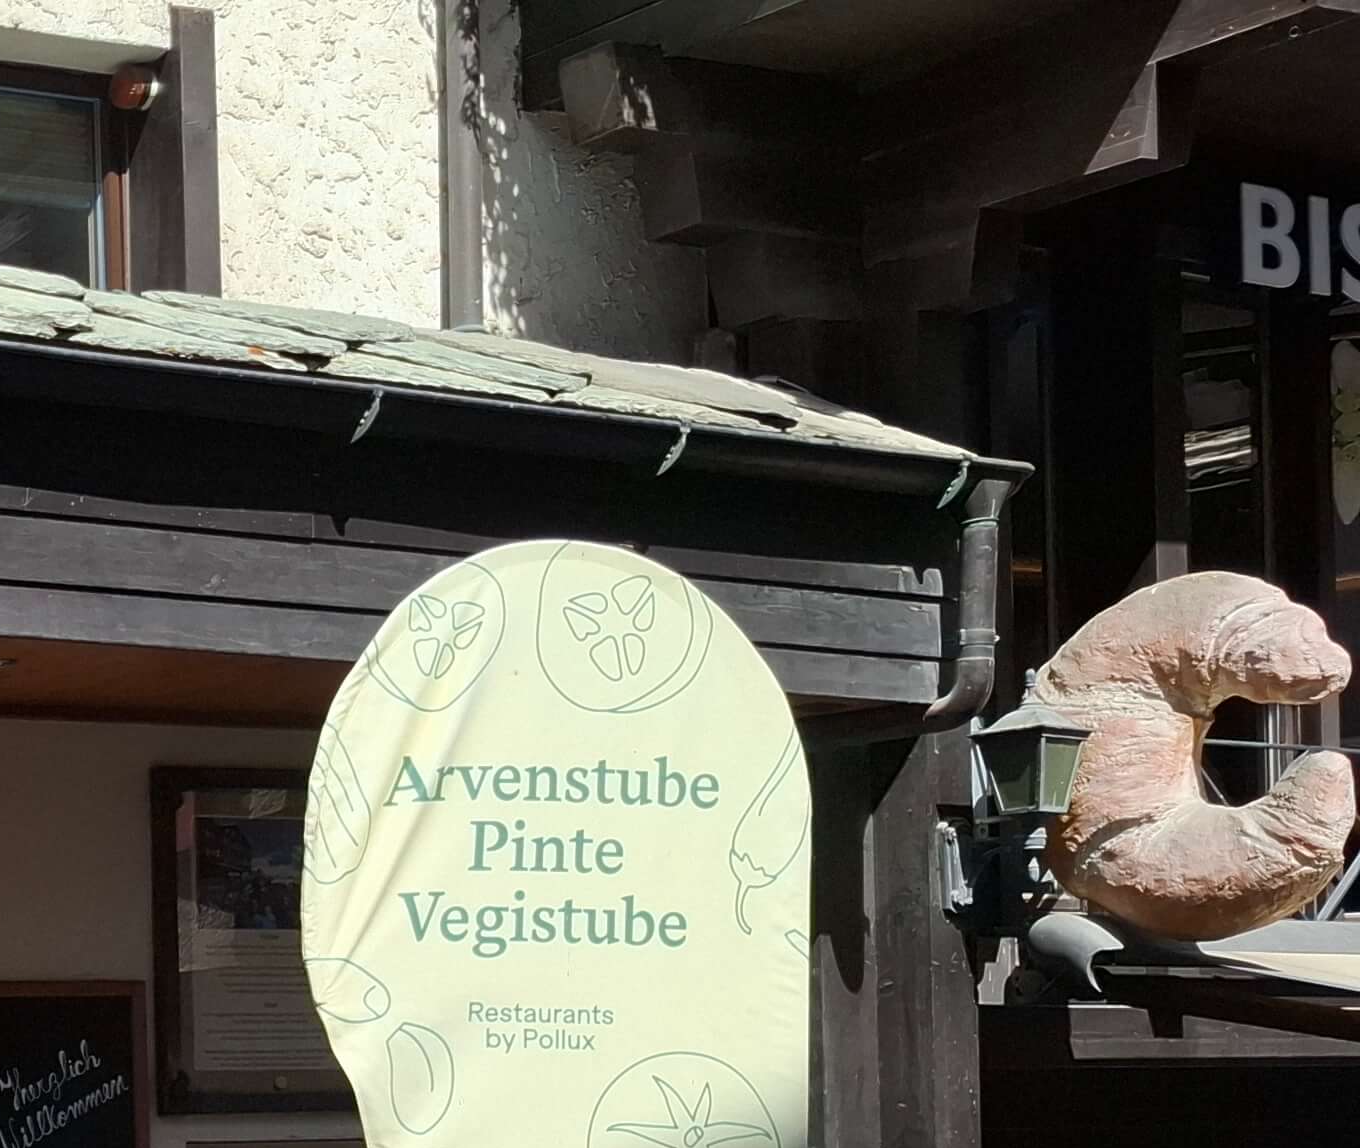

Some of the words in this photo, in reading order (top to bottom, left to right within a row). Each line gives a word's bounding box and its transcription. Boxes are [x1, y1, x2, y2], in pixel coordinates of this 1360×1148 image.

[383, 756, 720, 808] Arvenstube
[468, 820, 625, 875] Pinte
[398, 890, 688, 959] Vegistube
[468, 1002, 614, 1025] Restaurants
[485, 1029, 515, 1051] by
[523, 1028, 596, 1051] Pollux
